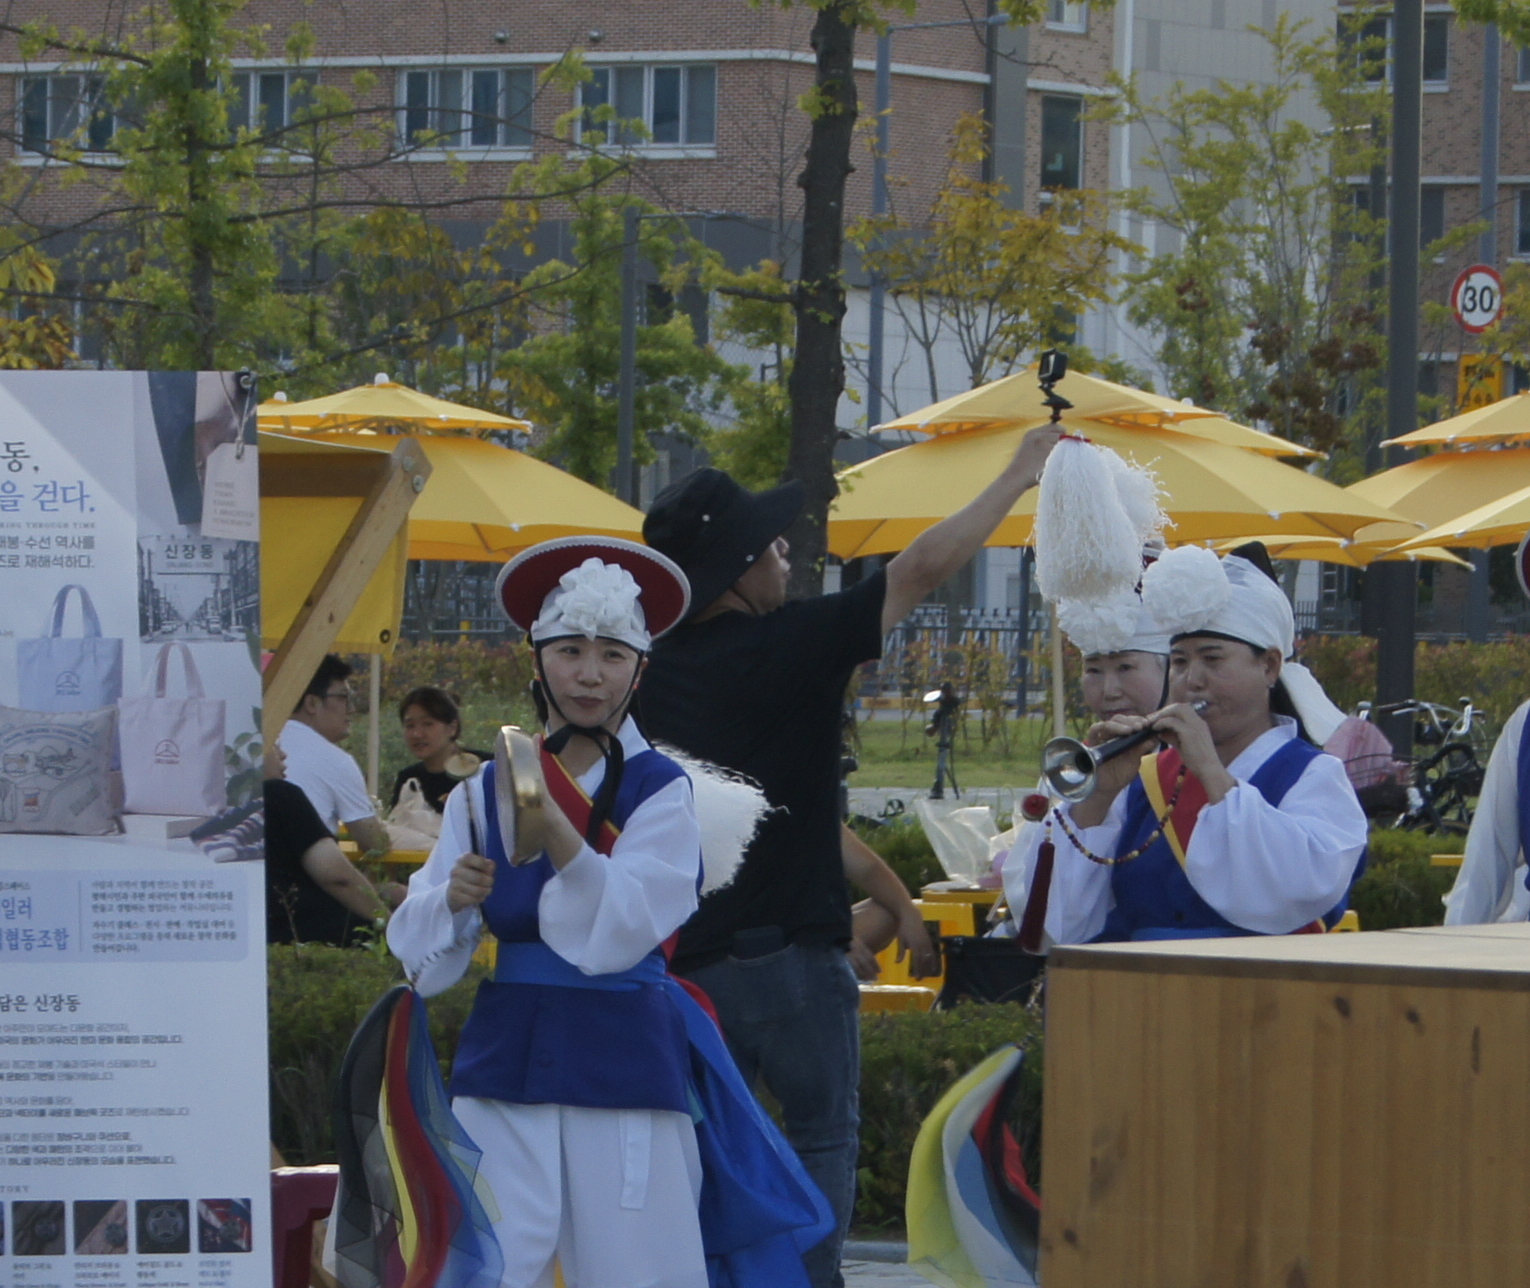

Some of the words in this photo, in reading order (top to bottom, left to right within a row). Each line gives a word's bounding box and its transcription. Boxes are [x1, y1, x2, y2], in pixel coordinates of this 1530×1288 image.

[1463, 286, 1494, 313] 30
[33, 480, 96, 513] 걷다.
[55, 535, 95, 550] 역사를
[164, 544, 213, 560] 신장동
[34, 994, 81, 1013] 신장동
